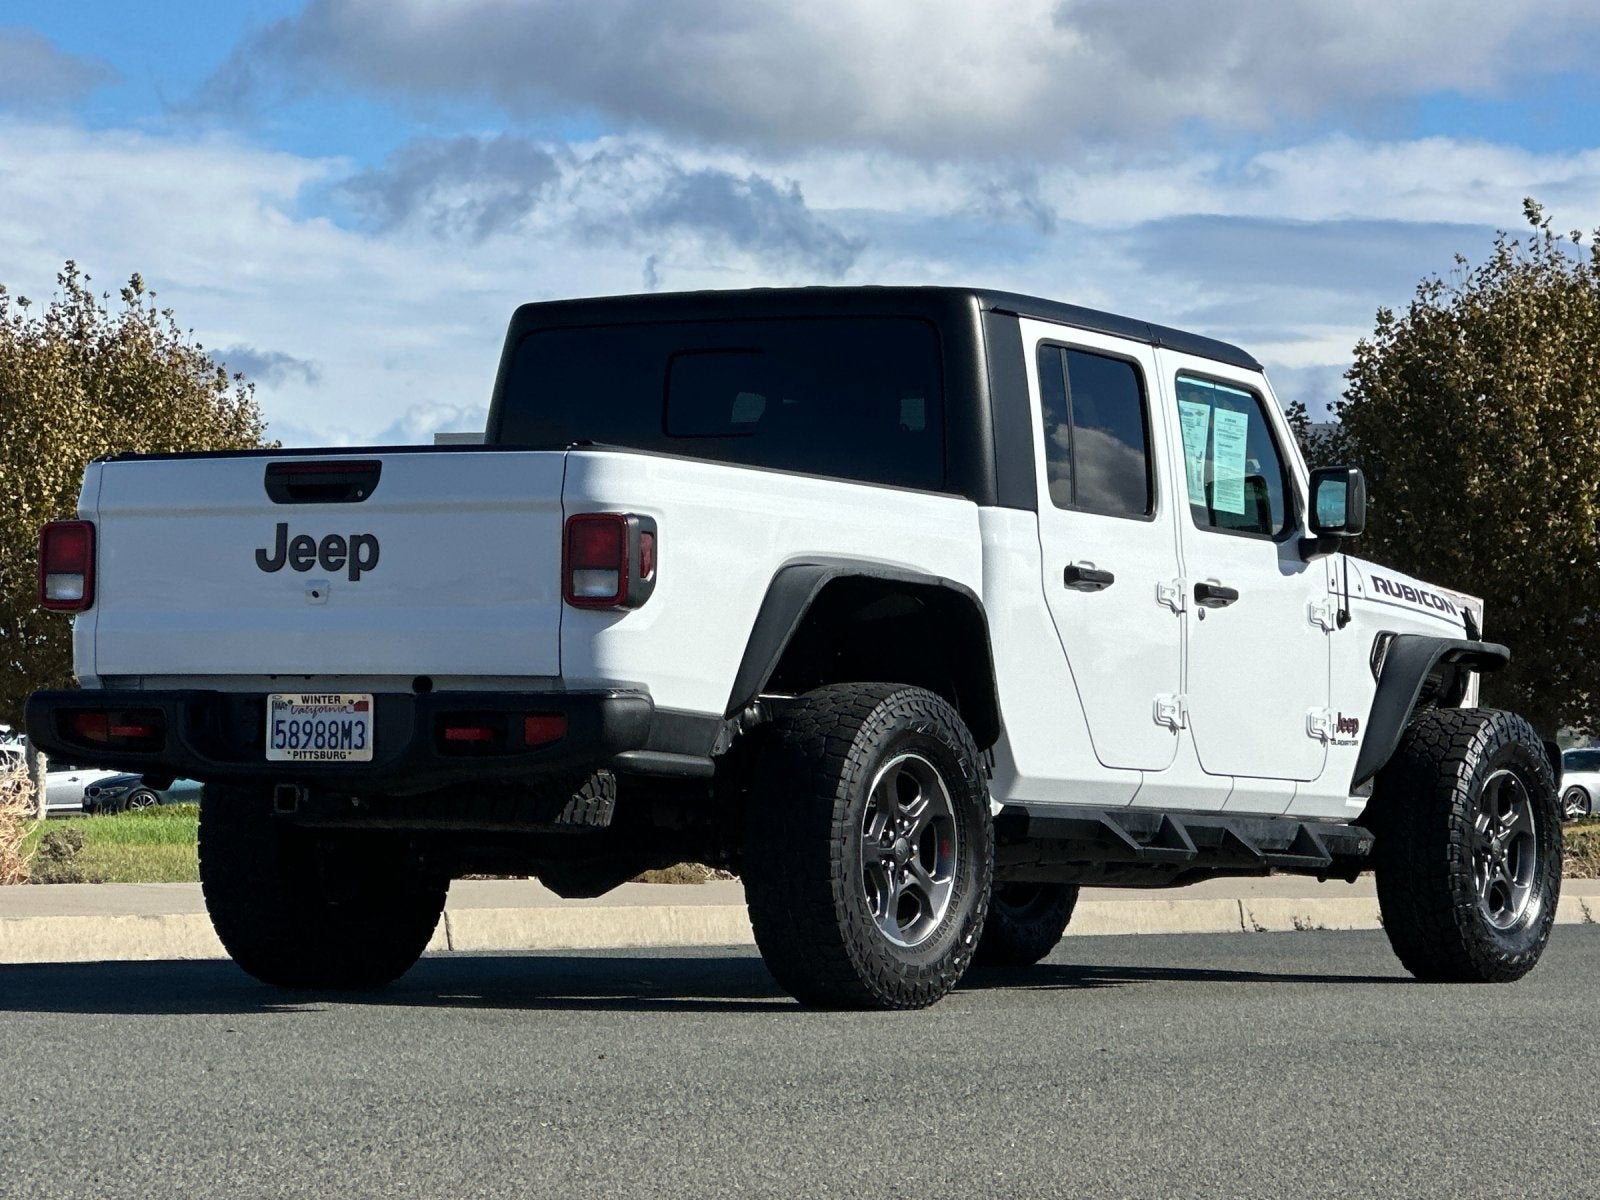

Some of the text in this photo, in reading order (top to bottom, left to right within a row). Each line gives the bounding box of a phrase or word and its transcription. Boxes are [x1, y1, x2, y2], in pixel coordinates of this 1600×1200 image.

[255, 522, 380, 581] Jeep
[1370, 575, 1458, 616] RUBICON
[290, 705, 355, 719] California
[301, 695, 342, 705] WINTER
[275, 720, 366, 750] 58988M3
[1336, 711, 1360, 738] Jeep
[292, 751, 347, 760] PITTSBURG
